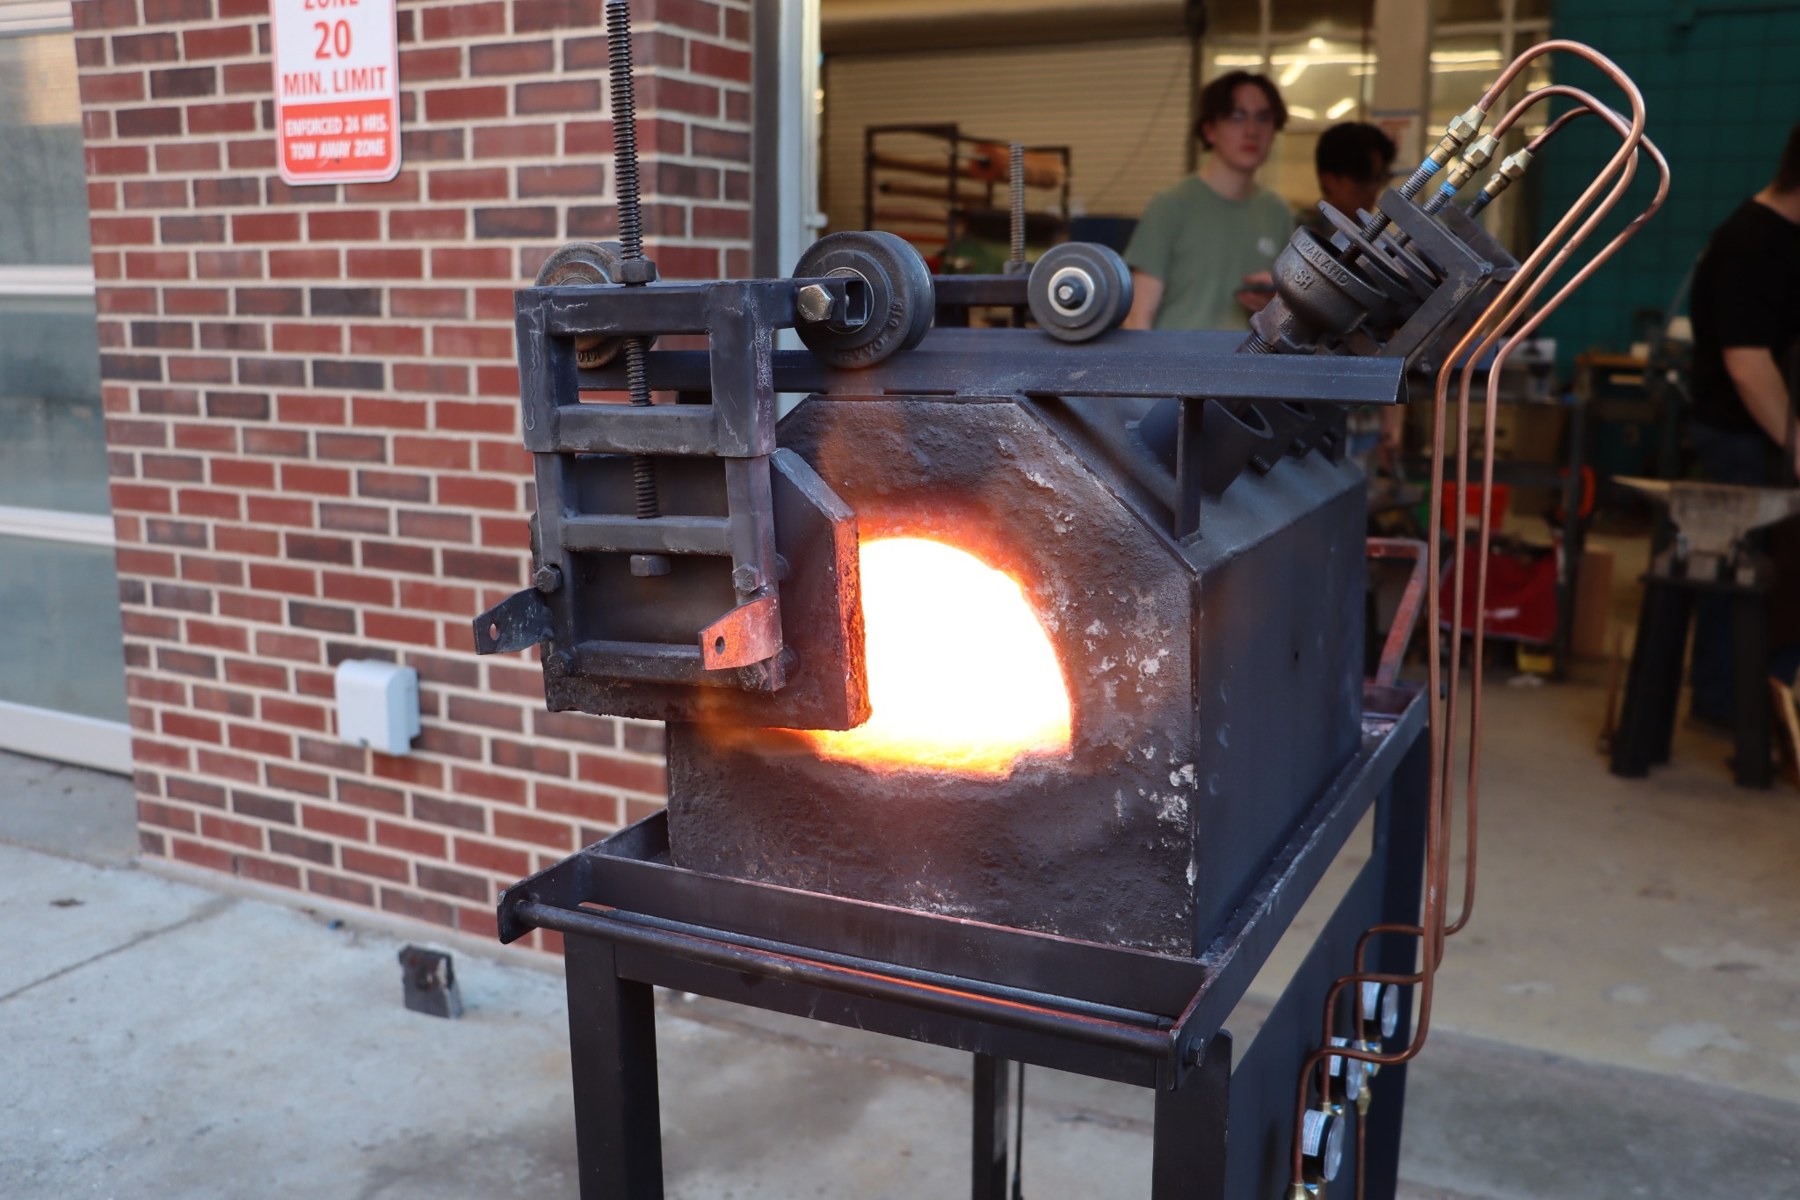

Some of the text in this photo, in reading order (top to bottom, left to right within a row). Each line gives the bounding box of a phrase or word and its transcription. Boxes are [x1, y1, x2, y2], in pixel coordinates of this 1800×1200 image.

[314, 19, 351, 59] 20
[283, 66, 387, 96] MIN. LIMIT
[285, 112, 390, 137] ENFORCED 24 HRS.
[290, 138, 386, 160] TOW AWAY ZONE
[1295, 238, 1348, 286] THAILAND
